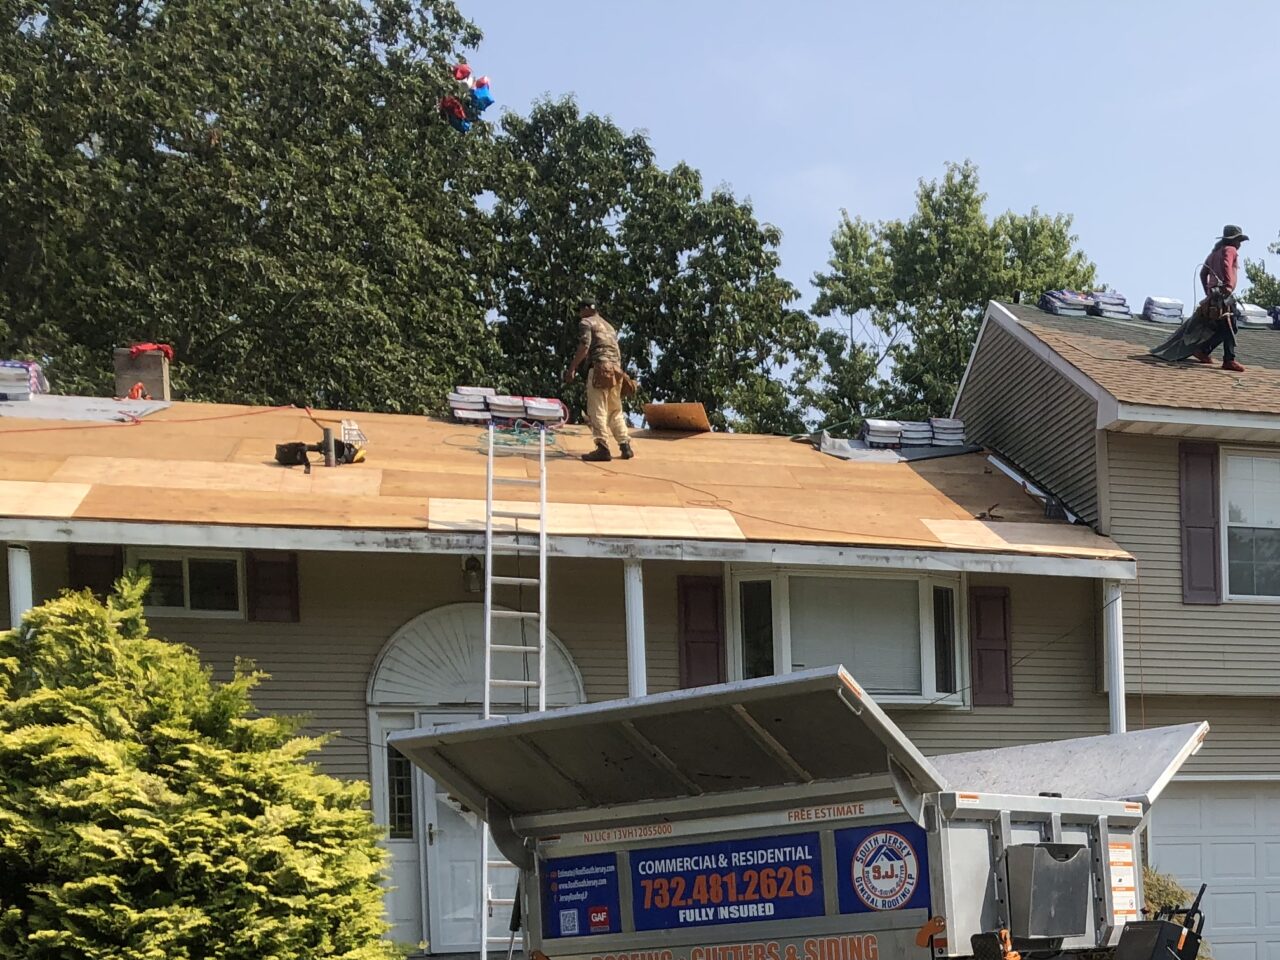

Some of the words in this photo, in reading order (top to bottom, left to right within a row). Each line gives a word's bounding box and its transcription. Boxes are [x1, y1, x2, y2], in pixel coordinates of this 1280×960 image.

[788, 809, 812, 822] FREE
[815, 804, 864, 819] ESTIMATE
[638, 854, 716, 875] COMMERCIAL
[718, 853, 728, 867] &
[732, 846, 812, 866] RESIDENTIAL
[856, 837, 879, 864] SOUTH
[882, 833, 911, 857] JERSEY
[872, 864, 898, 880] S.J.
[640, 865, 814, 909] 732.481.2626
[856, 877, 878, 907] GENERAL
[882, 888, 911, 908] ROOFING
[906, 874, 915, 887] LP
[591, 912, 607, 922] GAF
[679, 907, 714, 922] FULLY
[717, 903, 774, 920] INSURED
